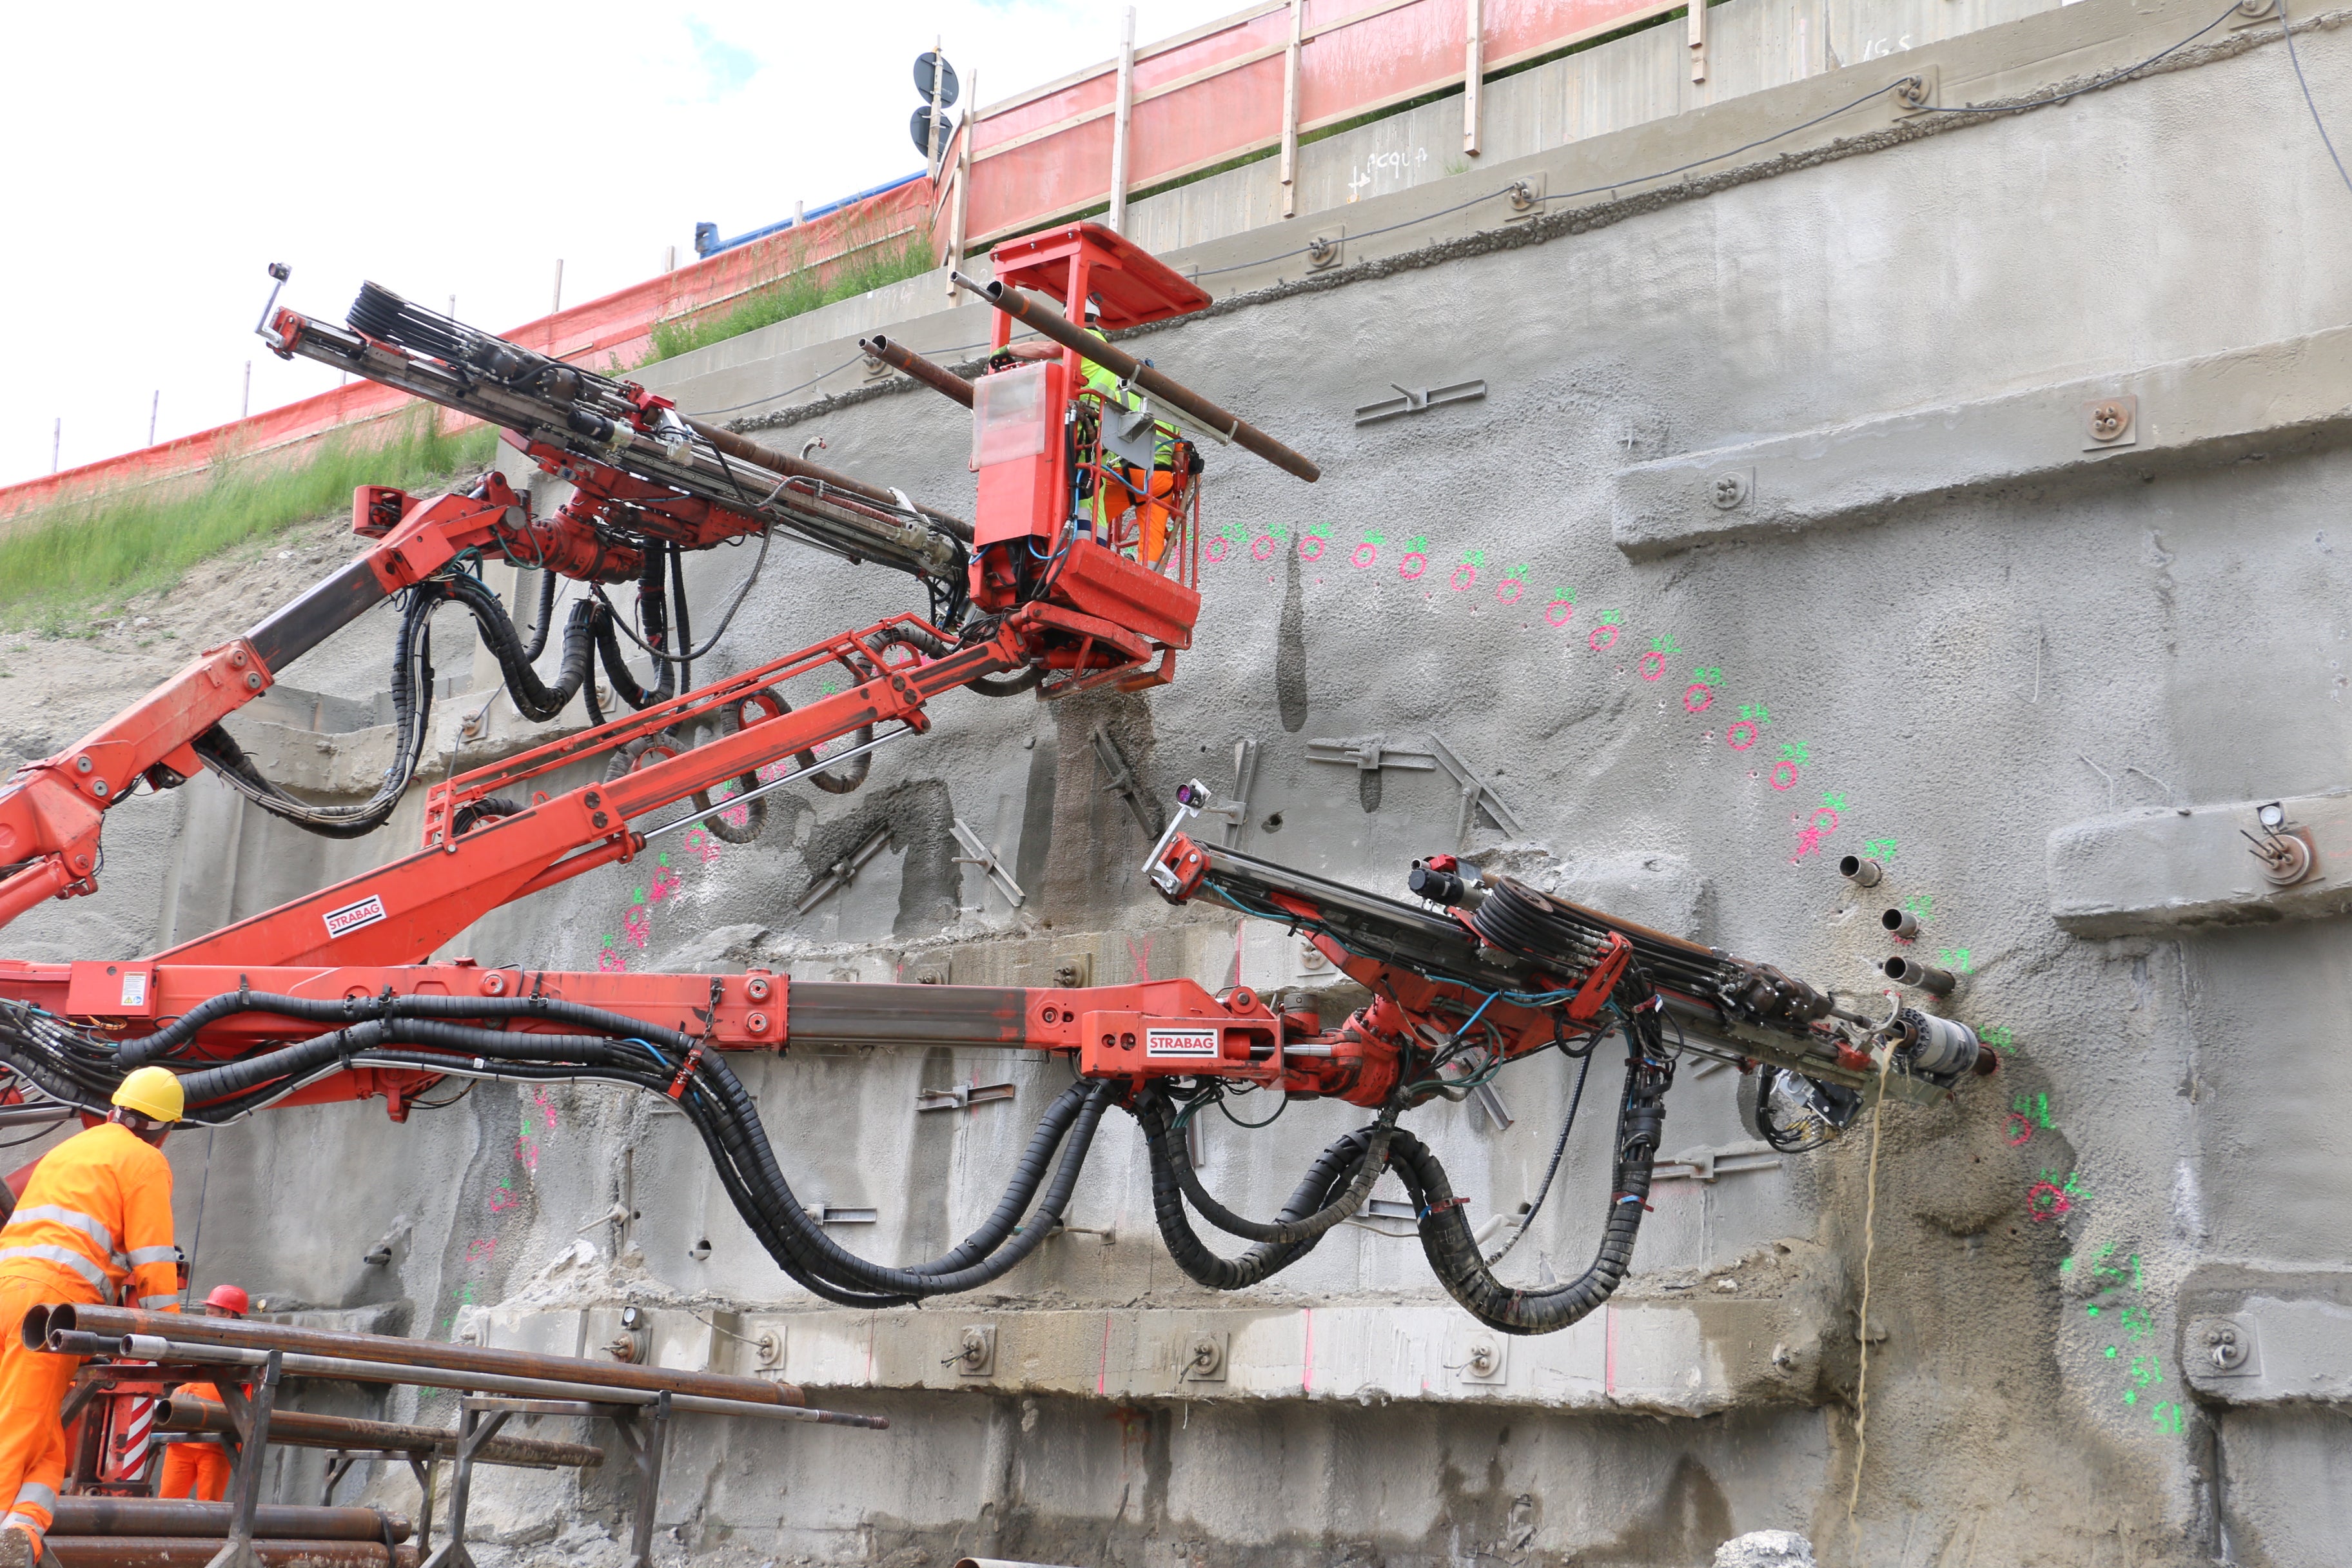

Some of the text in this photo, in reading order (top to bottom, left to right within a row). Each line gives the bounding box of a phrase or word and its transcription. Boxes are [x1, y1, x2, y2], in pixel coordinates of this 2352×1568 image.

[1367, 147, 1429, 179] ACQUA
[329, 904, 380, 930] STRABAG
[1150, 1037, 1214, 1049] STRABAG
[2131, 1355, 2164, 1388] 51
[2151, 1400, 2185, 1435] 51
